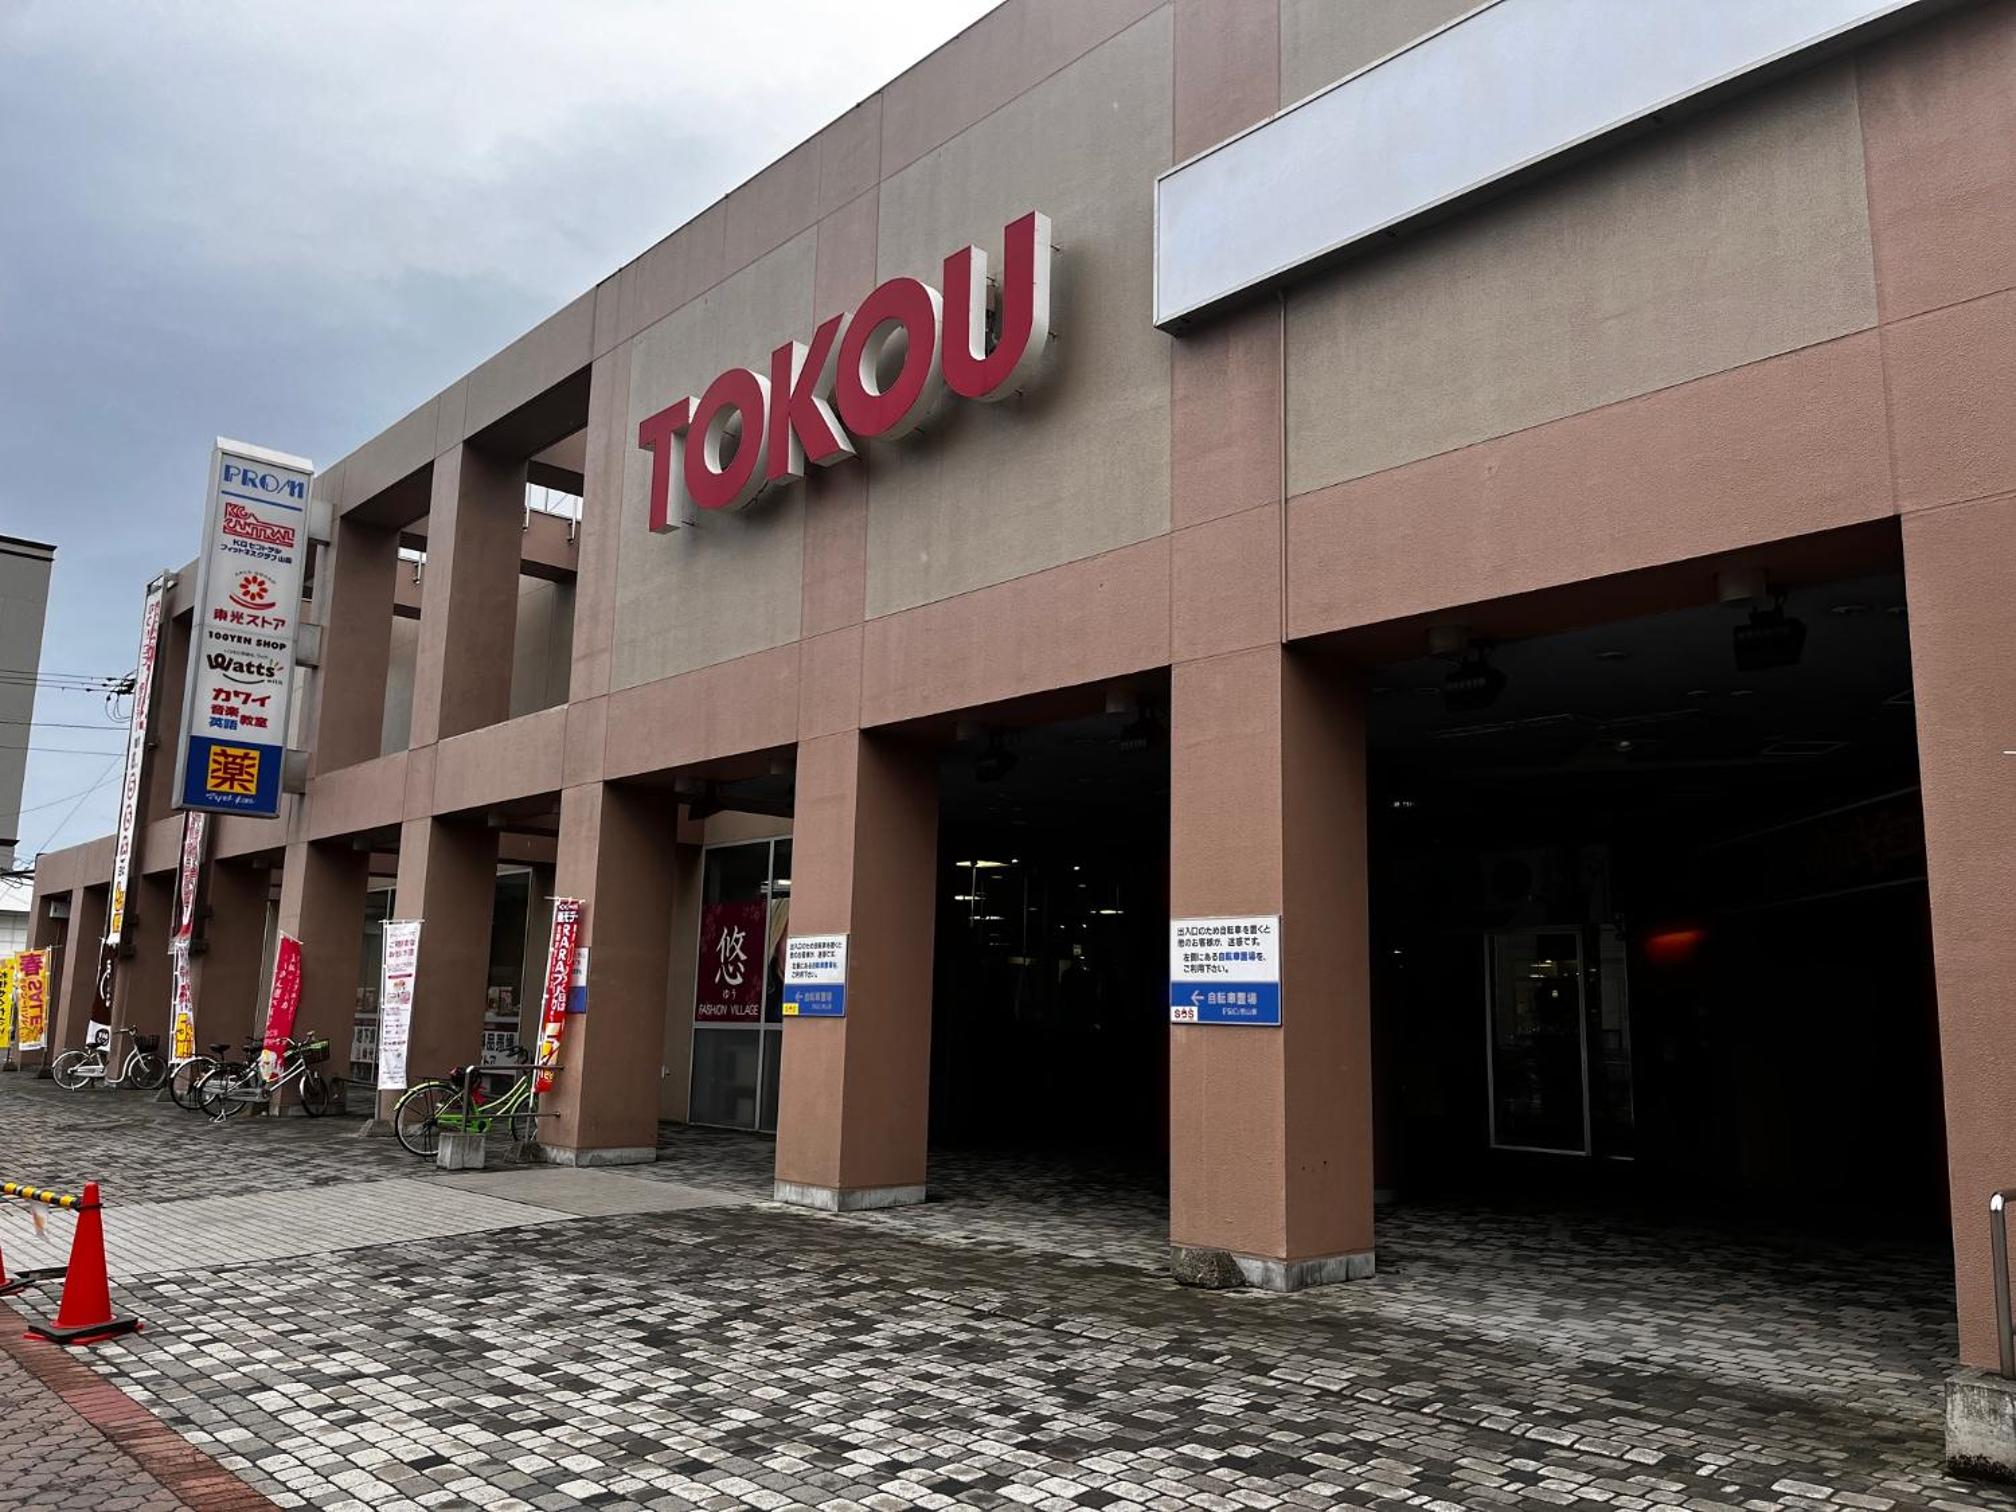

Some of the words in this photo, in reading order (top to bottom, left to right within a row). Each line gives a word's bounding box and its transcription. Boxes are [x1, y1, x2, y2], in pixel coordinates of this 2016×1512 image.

[638, 209, 1051, 534] TOKOU
[213, 608, 286, 631] 東光ストア
[208, 631, 252, 645] 100YEN
[256, 639, 287, 651] SHOP
[207, 653, 275, 678] Watts
[213, 688, 271, 707] カワイ
[210, 749, 257, 792] 薬
[715, 925, 748, 986] 悠
[731, 1004, 759, 1016] VILLAGE
